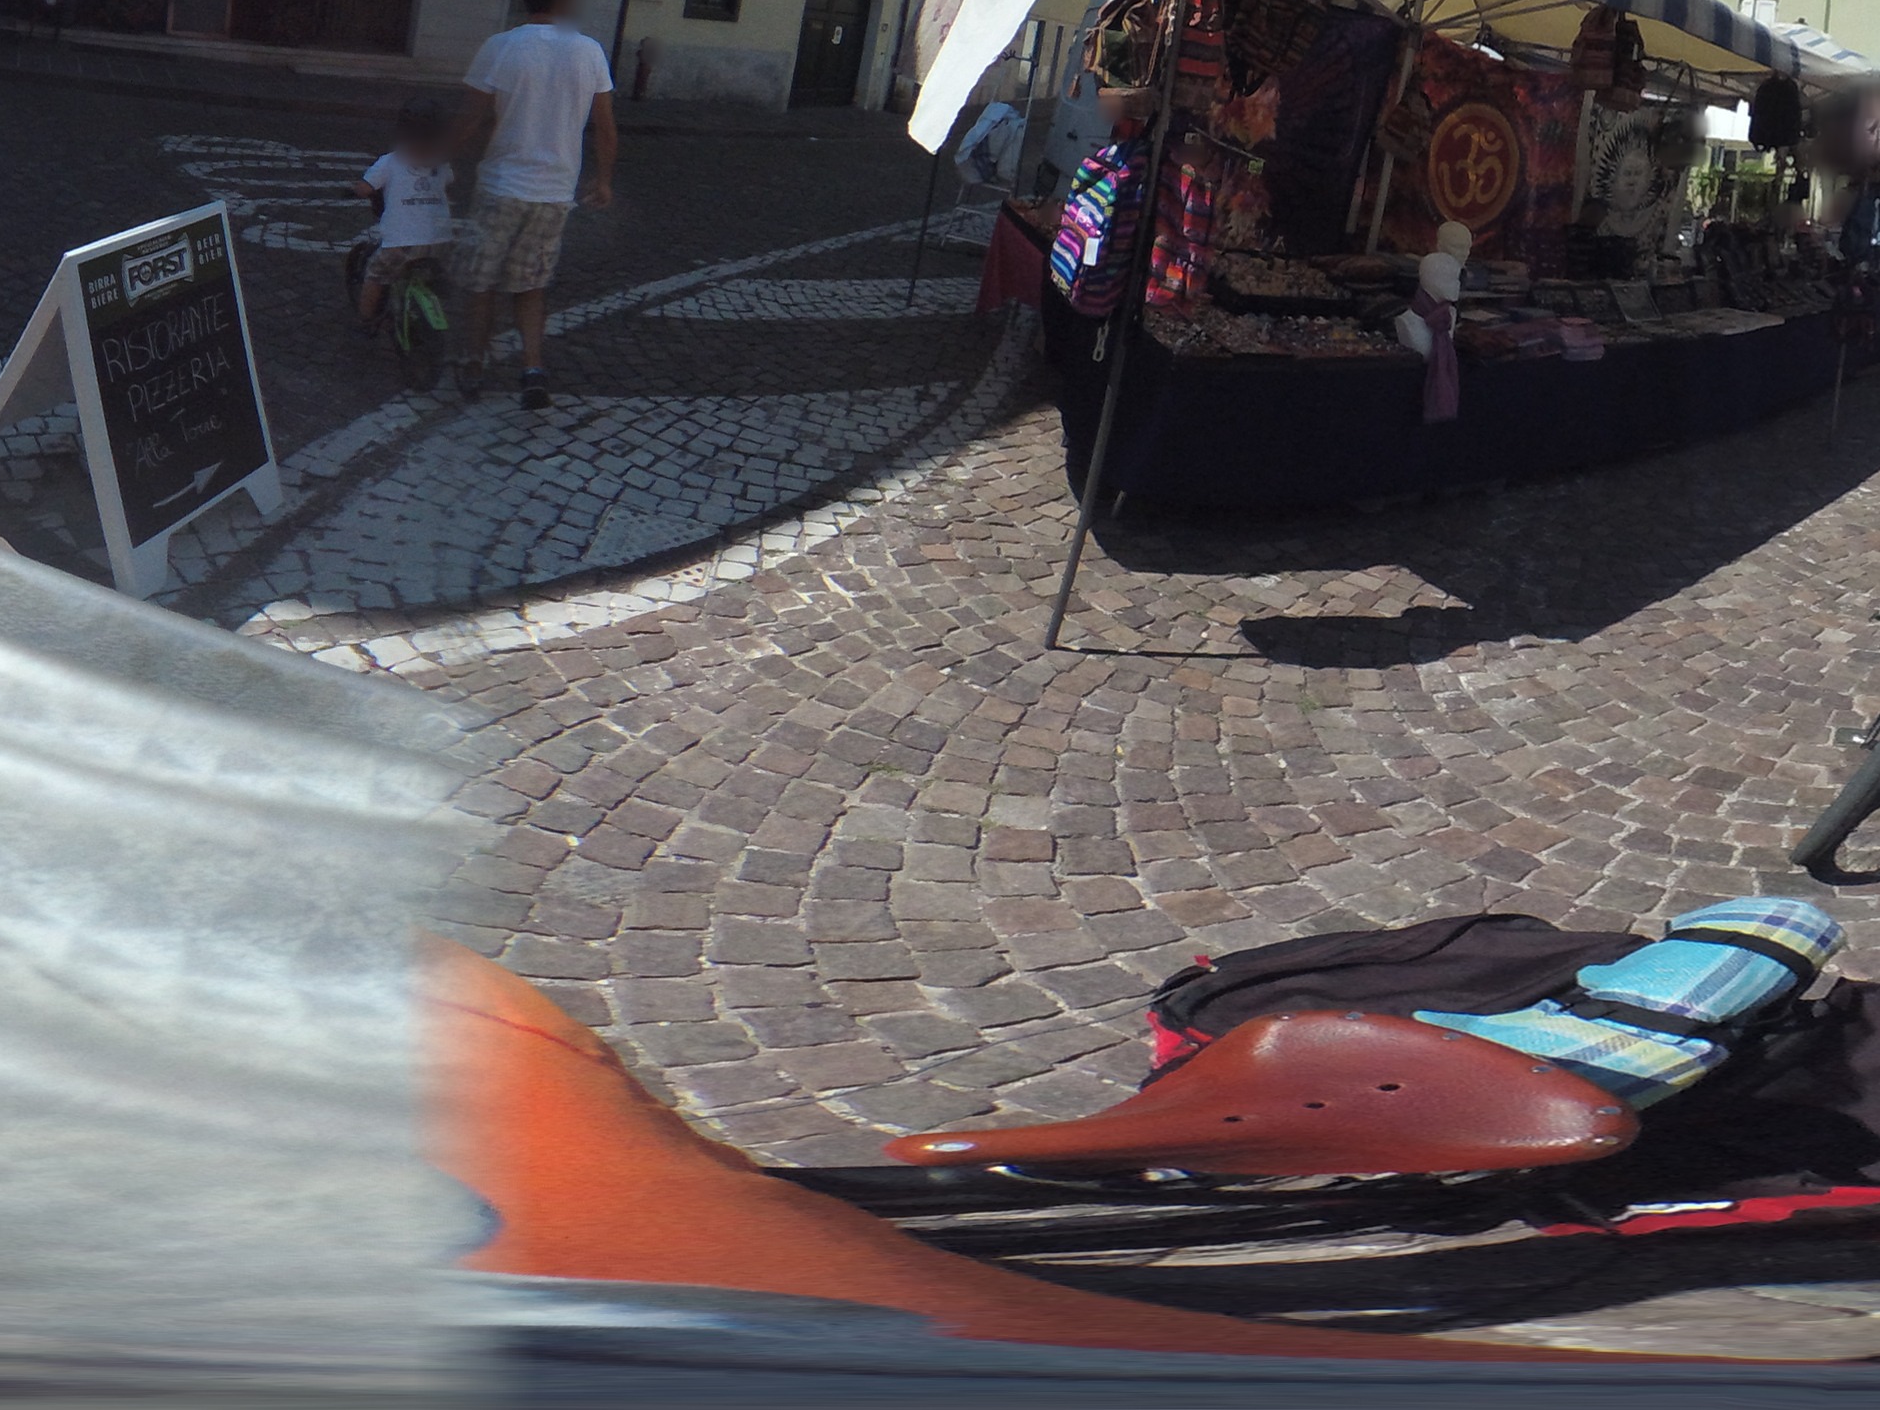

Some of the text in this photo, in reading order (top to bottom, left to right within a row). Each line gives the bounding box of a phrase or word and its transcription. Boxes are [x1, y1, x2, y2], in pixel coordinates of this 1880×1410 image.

[196, 233, 221, 251] BEER
[198, 247, 223, 265] BIER
[88, 273, 117, 294] BIRRA
[128, 247, 188, 292] FORST
[101, 292, 229, 383] RISTORANTE
[127, 346, 231, 422] PIZZERIA
